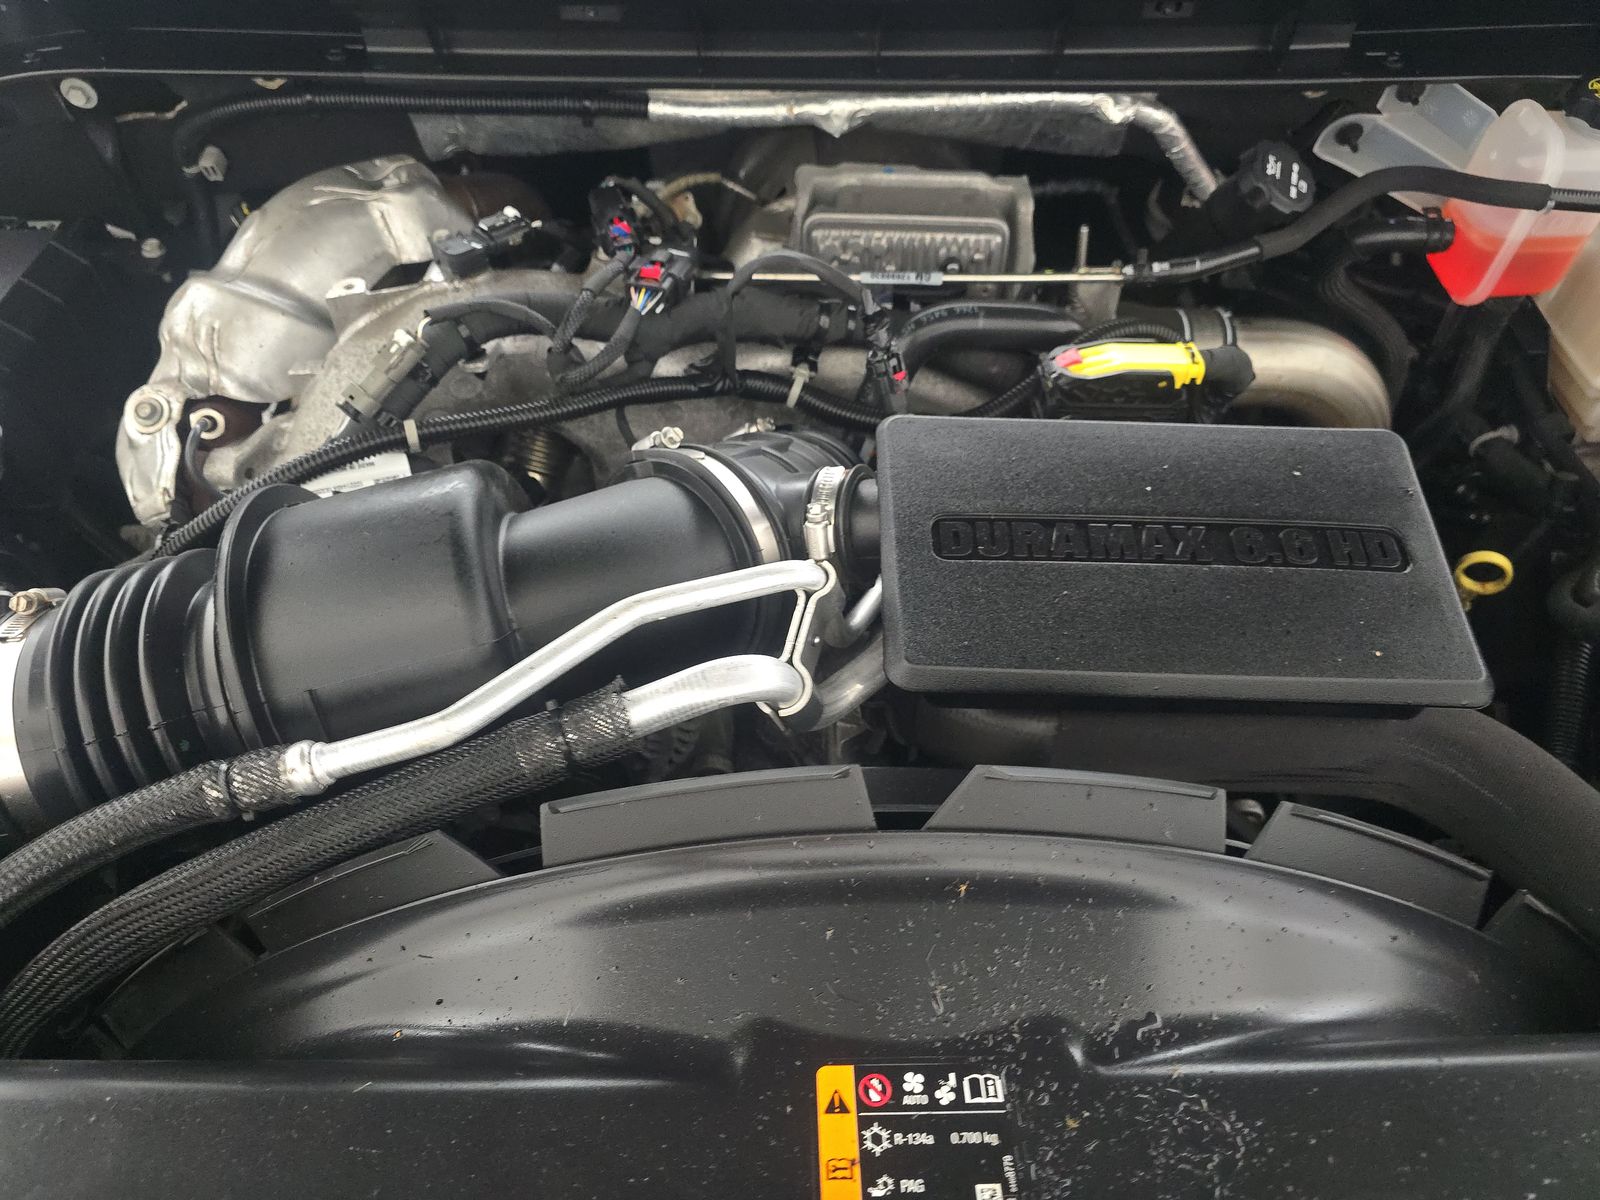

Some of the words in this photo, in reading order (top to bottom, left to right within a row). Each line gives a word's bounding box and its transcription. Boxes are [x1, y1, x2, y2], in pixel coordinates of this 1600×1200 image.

[938, 520, 1214, 562] DURAMAX
[1229, 526, 1318, 565] 6.6
[1326, 530, 1402, 568] HD
[902, 1094, 929, 1106] AUTO
[893, 1132, 935, 1145] R-134a
[949, 1131, 982, 1145] 0.700
[983, 1131, 1000, 1146] kg
[900, 1178, 926, 1193] PAG
